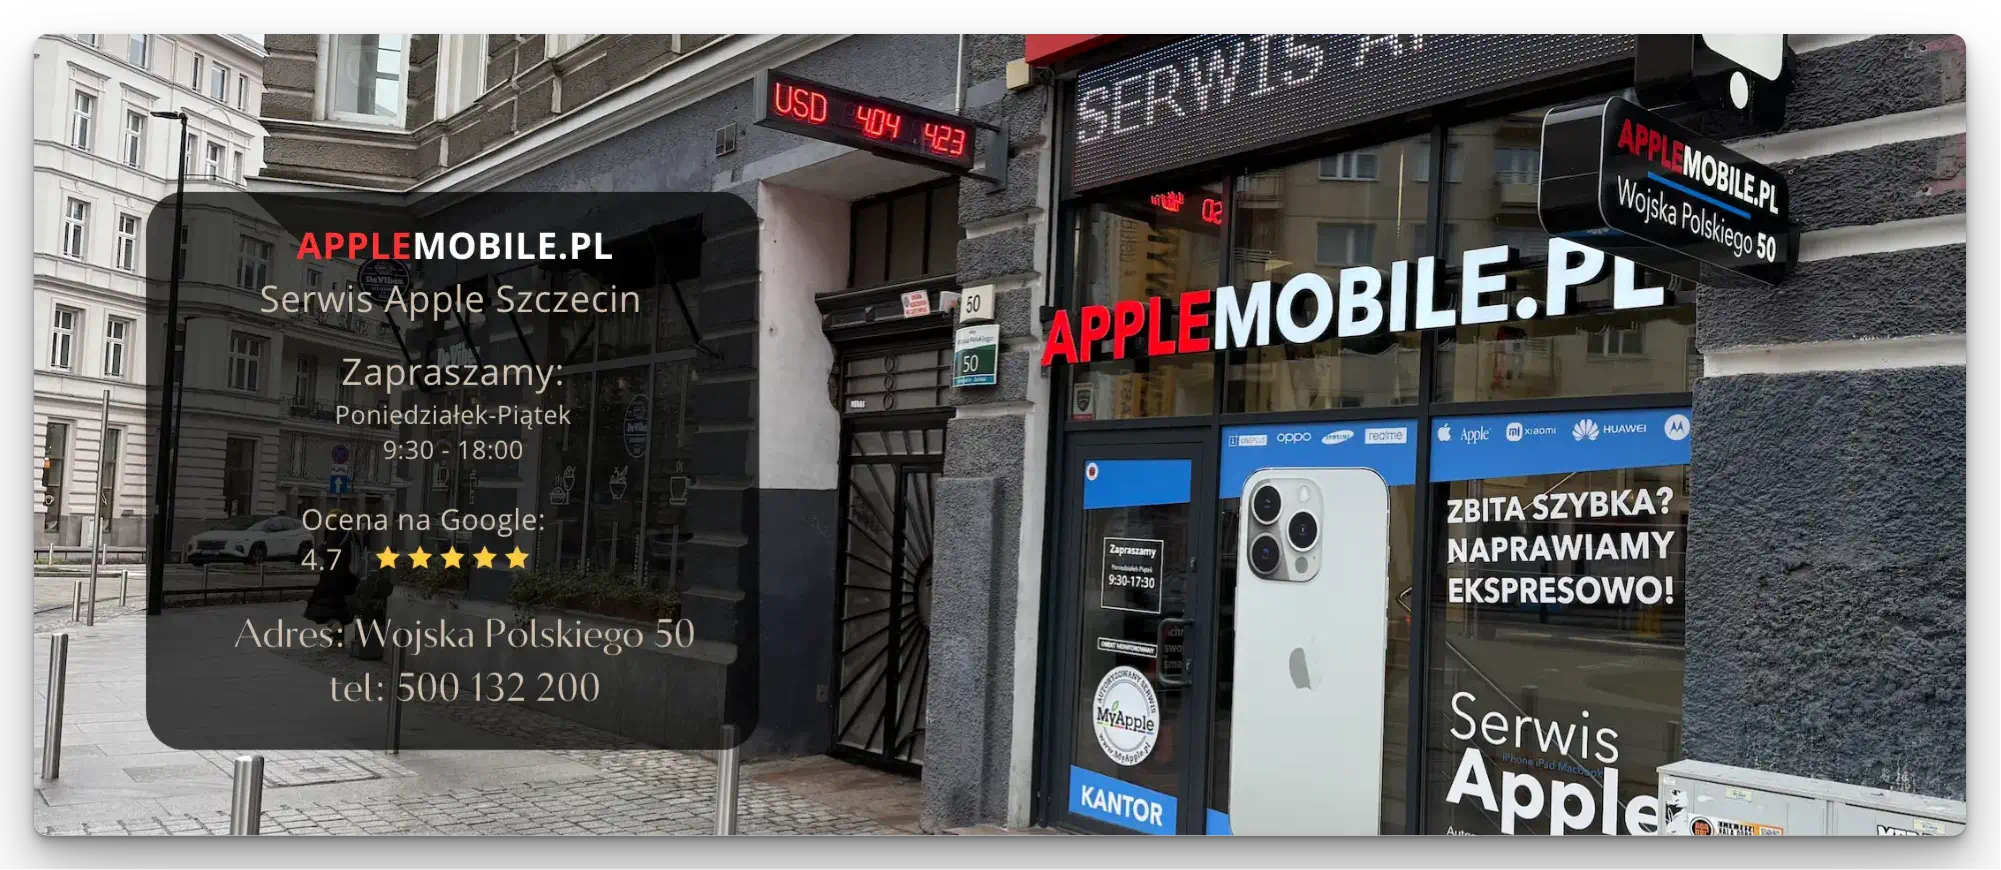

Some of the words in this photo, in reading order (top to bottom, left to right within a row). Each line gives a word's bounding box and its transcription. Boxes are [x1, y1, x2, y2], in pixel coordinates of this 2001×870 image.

[775, 82, 828, 122] USD
[1077, 34, 1323, 142] SERWIS
[1618, 118, 1779, 215] APPLEMOBILE.PL
[1618, 175, 1677, 224] Wojska
[1682, 202, 1753, 258] Polskiego
[1756, 232, 1776, 263] 50
[966, 295, 981, 313] 50
[1040, 237, 1664, 367] APPLEMOBILE.PL
[962, 354, 979, 373] 50
[1276, 432, 1312, 444] oppo
[1368, 430, 1404, 442] realme
[1460, 427, 1490, 444] Apple
[1524, 426, 1557, 435] xiaomi
[1603, 424, 1647, 434] HUAWEI
[1447, 496, 1526, 523] ZBITA
[1532, 486, 1674, 521] SZYBKA?
[1109, 544, 1156, 558] Zapraszamy
[1447, 530, 1676, 564] NAPRAWIAMY
[1108, 574, 1155, 589] 9:30-17:30
[1448, 575, 1674, 605] EKSPRESOWO!
[1096, 670, 1141, 704] AUTORYZOWANY
[1139, 678, 1157, 714] SERWIS
[1096, 706, 1154, 732] MyApple
[1450, 691, 1619, 764] Serwis
[1502, 752, 1533, 767] iPhone
[1081, 785, 1163, 827] KANTOR
[1445, 747, 1658, 836] Apple
